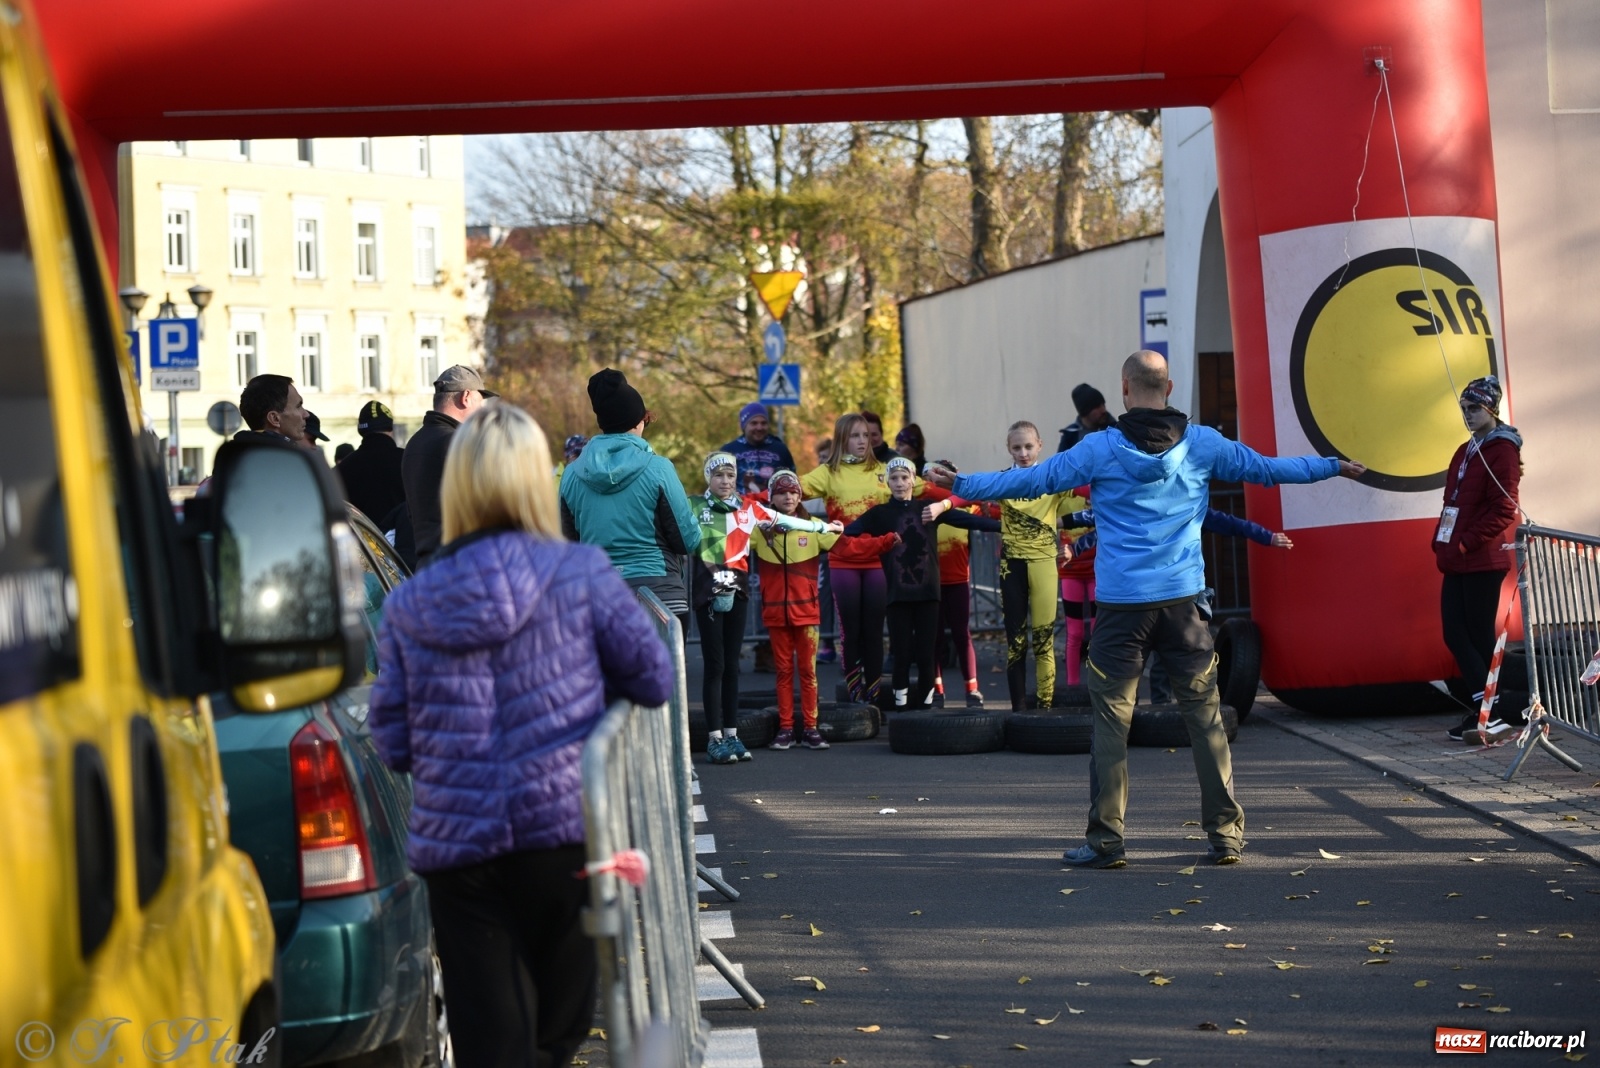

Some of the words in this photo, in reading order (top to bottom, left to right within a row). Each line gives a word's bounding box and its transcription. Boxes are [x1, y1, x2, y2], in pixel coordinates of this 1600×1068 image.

[1395, 287, 1492, 336] SIR
[158, 323, 189, 364] P
[156, 375, 195, 387] Koniec
